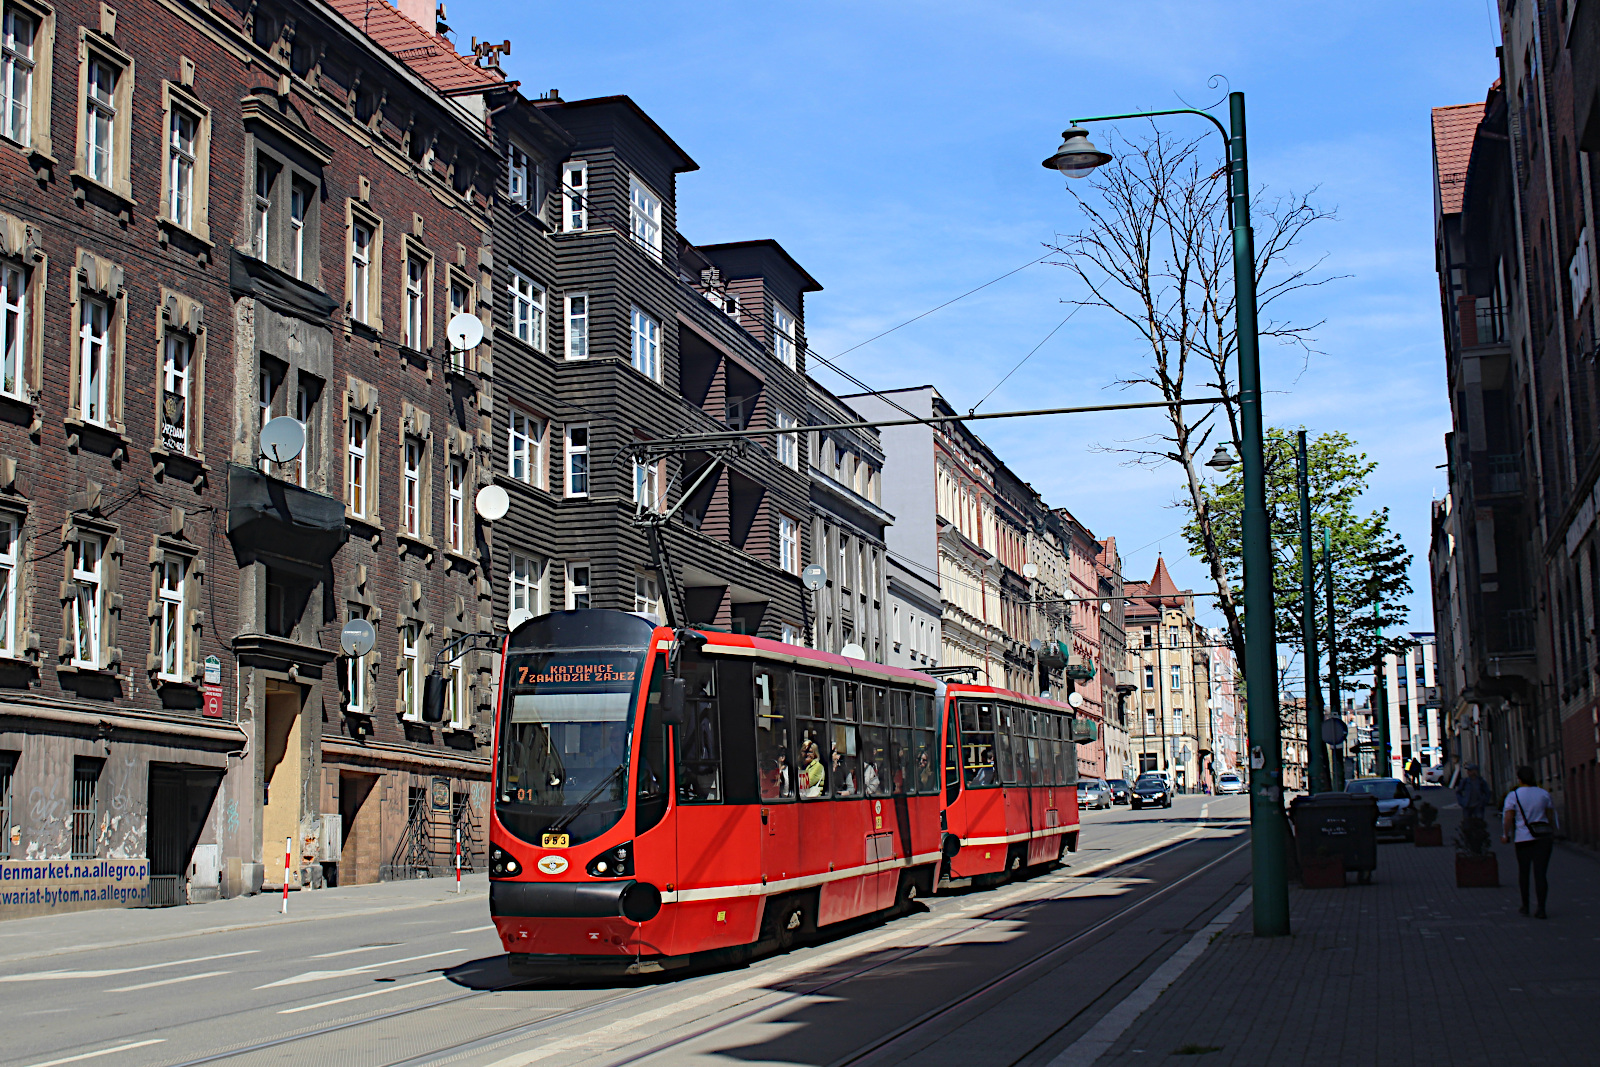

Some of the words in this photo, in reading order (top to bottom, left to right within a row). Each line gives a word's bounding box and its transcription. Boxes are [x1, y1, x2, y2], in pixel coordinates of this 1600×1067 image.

[518, 666, 529, 684] 7
[550, 664, 614, 674] KATOWICE
[529, 673, 591, 683] ZAWODZIE
[595, 671, 635, 681] ZAJEZ
[517, 788, 533, 801] 01
[544, 836, 566, 845] 653
[0, 884, 150, 907] wariat-bytom.na.allegro.pl
